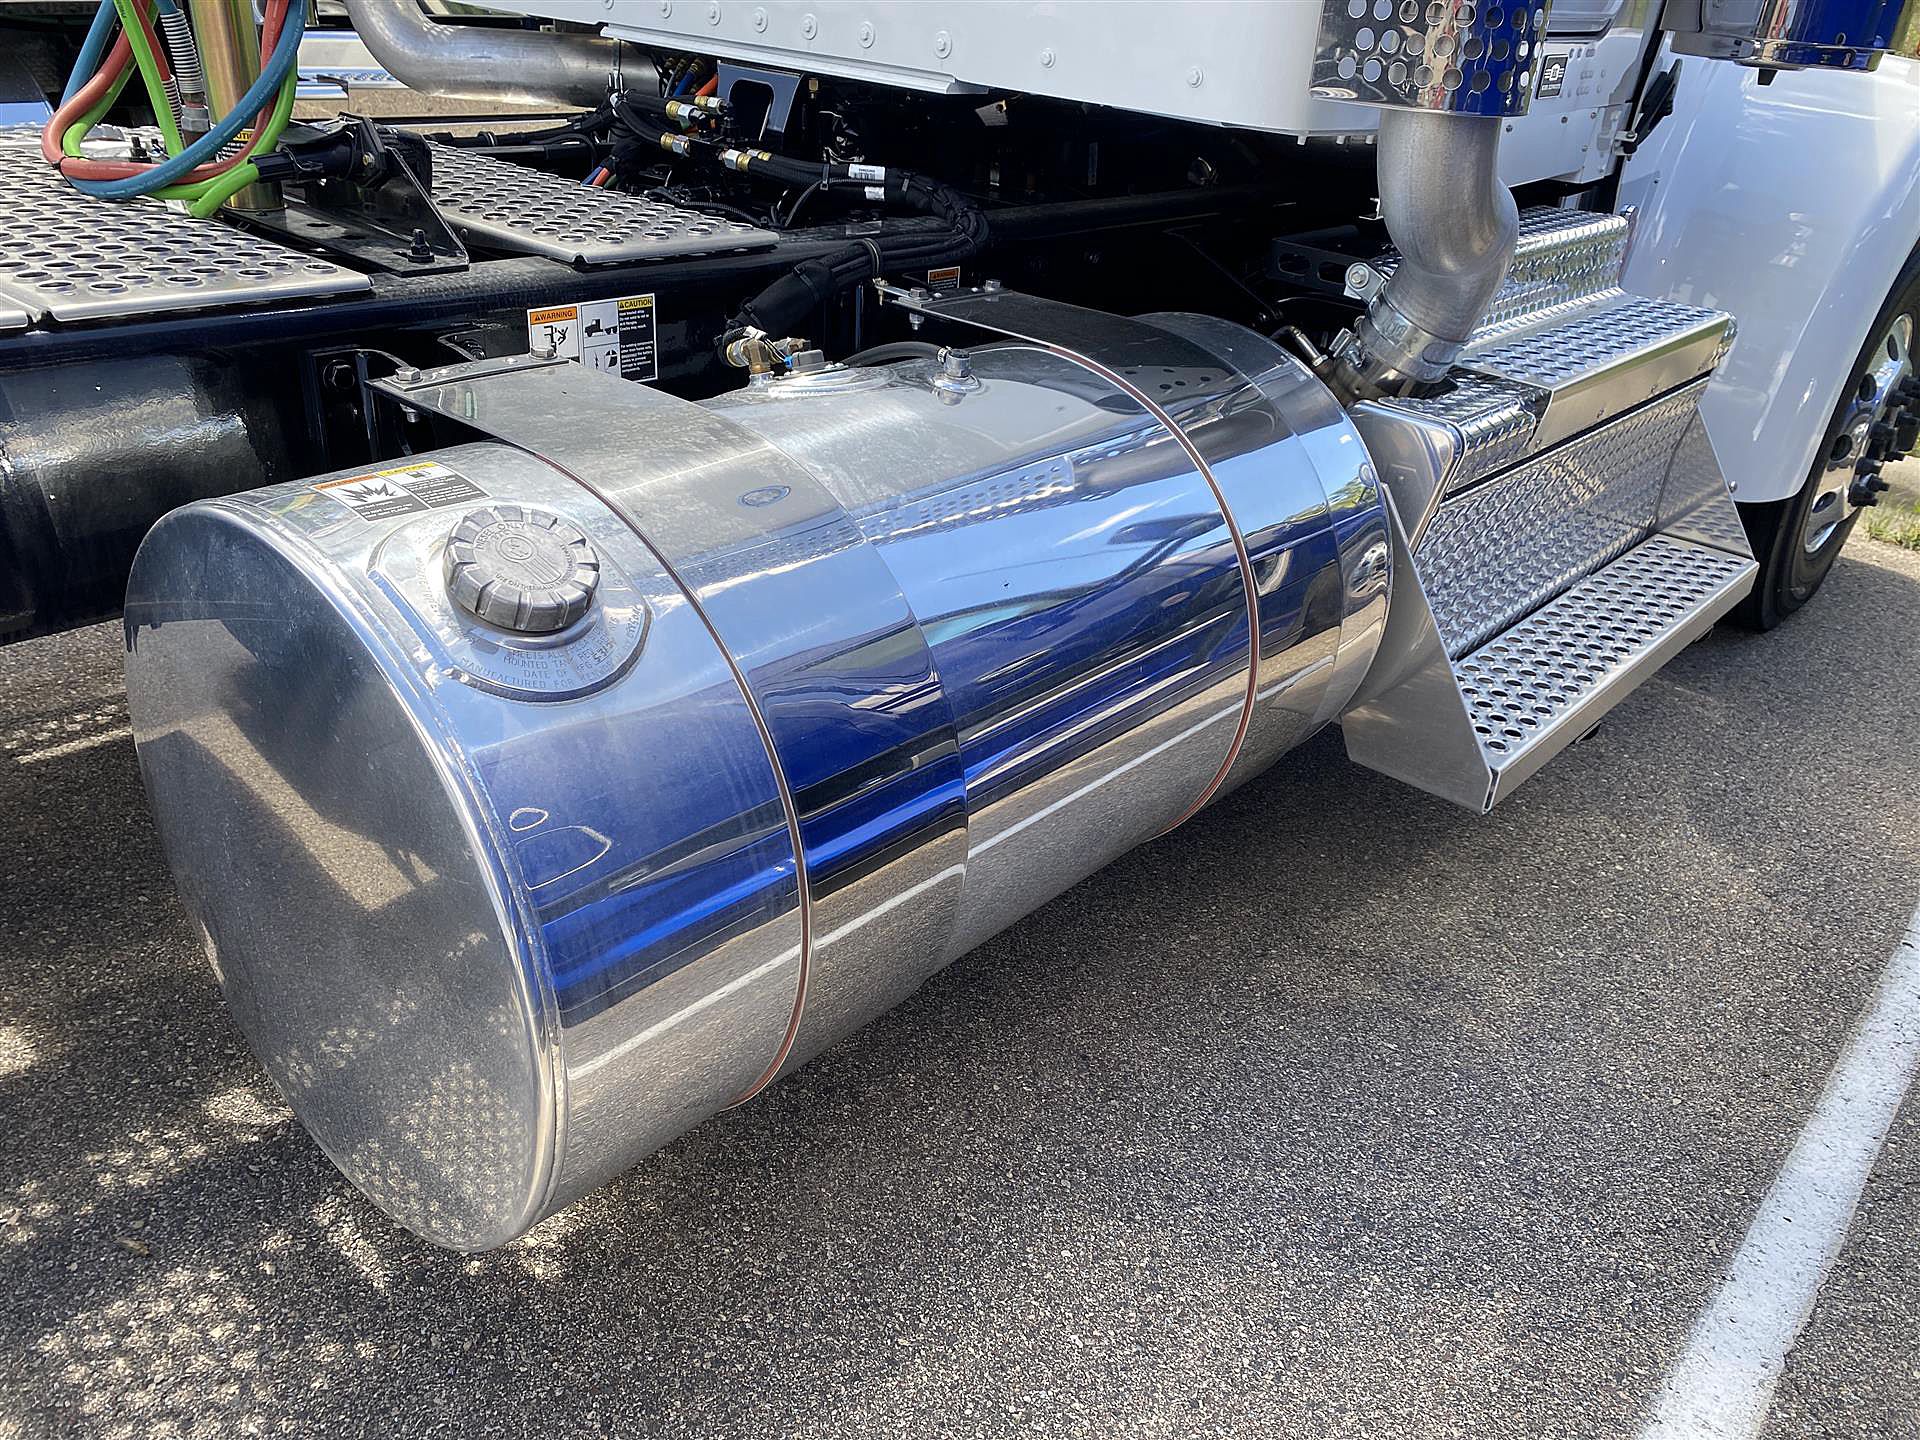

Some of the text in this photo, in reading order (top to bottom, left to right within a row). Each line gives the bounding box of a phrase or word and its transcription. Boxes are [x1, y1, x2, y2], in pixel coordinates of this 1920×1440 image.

[624, 297, 652, 308] CAUTION
[540, 310, 573, 321] WARNING
[476, 528, 494, 549] DIESEL
[498, 522, 526, 530] ONLY
[503, 656, 548, 669] MOUNTED
[461, 657, 574, 688] MANUFACTURED FOR
[524, 670, 551, 679] DATE
